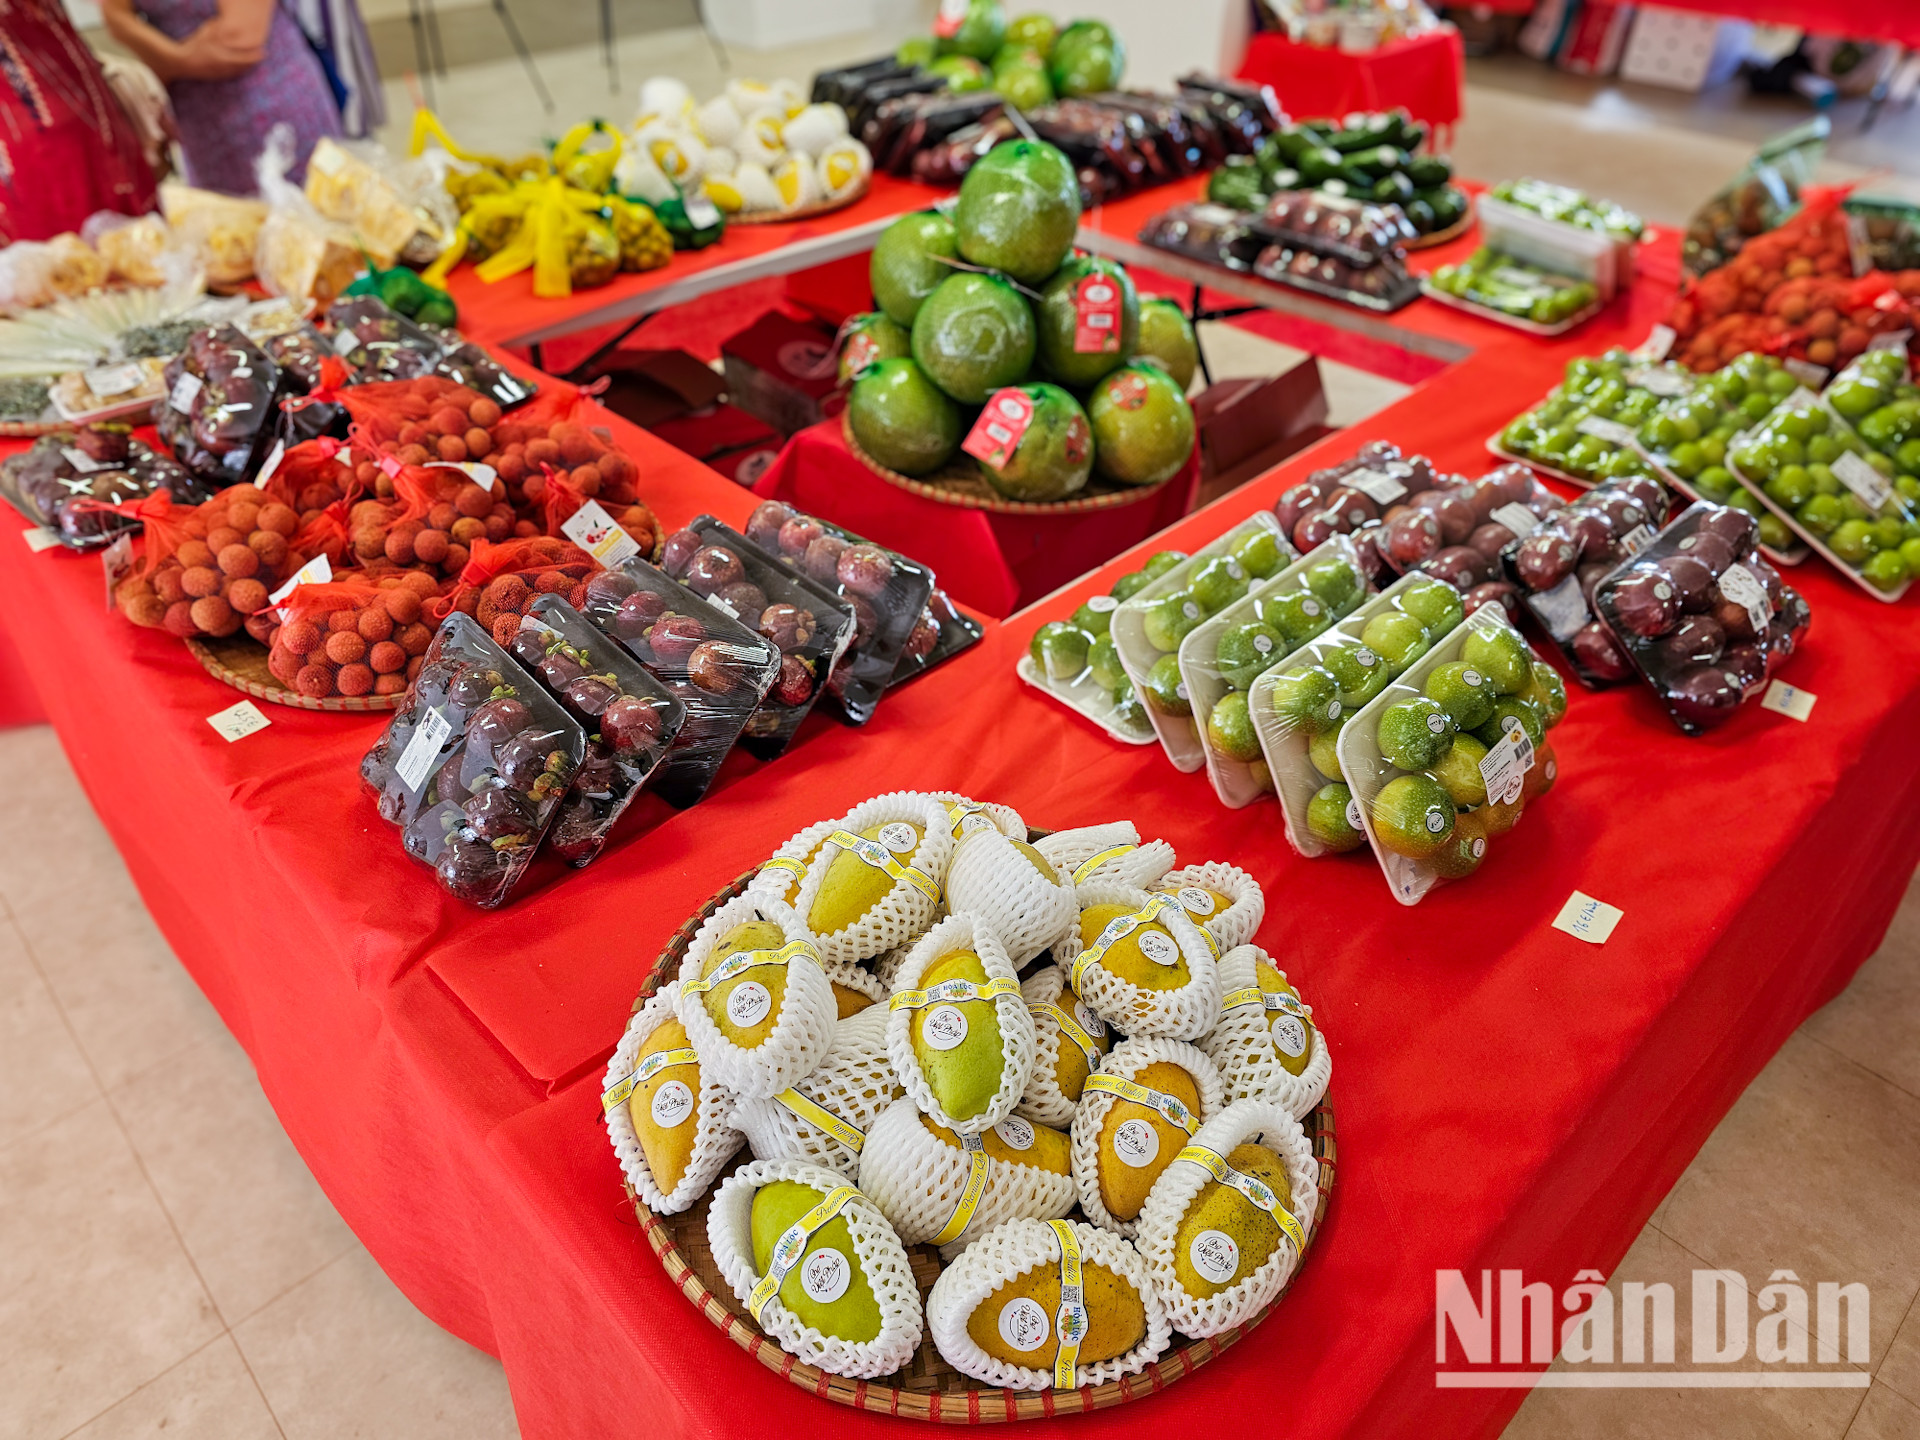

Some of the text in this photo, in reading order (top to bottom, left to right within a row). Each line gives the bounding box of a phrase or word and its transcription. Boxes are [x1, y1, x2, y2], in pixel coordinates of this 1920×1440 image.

[1115, 1081, 1144, 1100] Quality
[1203, 1153, 1225, 1177] Quality
[816, 1191, 848, 1221] Premium
[961, 1172, 982, 1214] Premium
[1065, 1248, 1080, 1283] Quality
